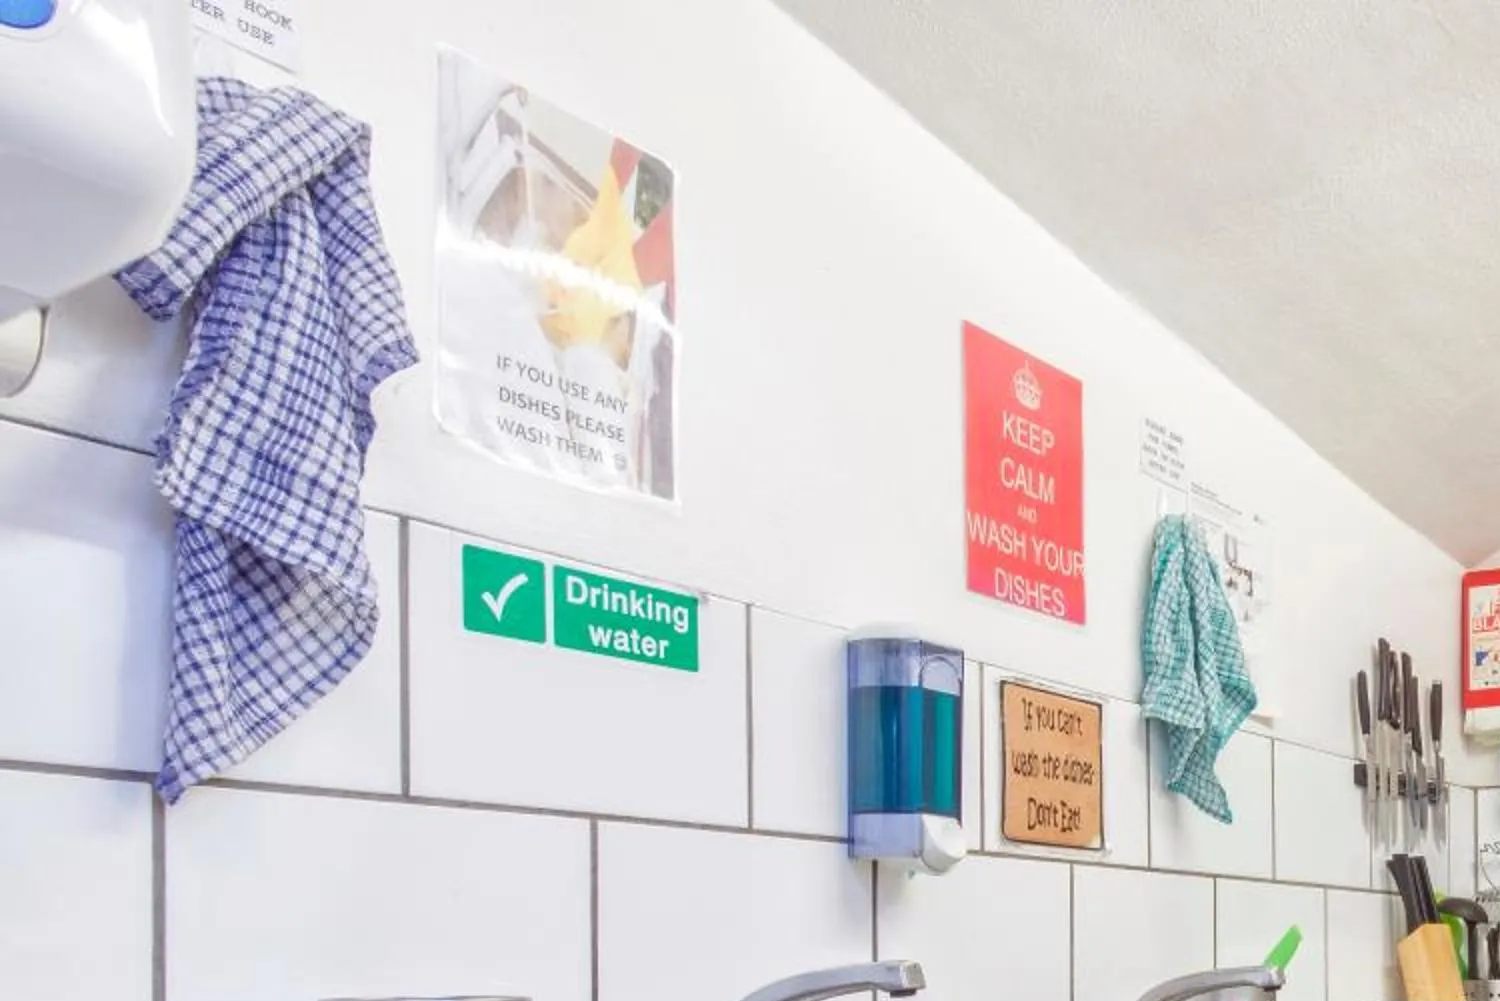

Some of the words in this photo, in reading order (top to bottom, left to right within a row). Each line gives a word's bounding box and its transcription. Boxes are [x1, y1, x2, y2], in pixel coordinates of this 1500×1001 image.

[238, 17, 274, 45] USE
[244, 0, 293, 31] HOOK
[496, 353, 511, 370] IF
[516, 360, 553, 388] YOU
[559, 375, 589, 401] USE
[595, 391, 628, 414] ANY
[499, 385, 560, 421] DISHES
[565, 408, 625, 443] PLEASE
[1003, 410, 1054, 456] KEEP
[497, 415, 551, 446] WASH
[556, 435, 603, 463] THEM
[1001, 457, 1054, 505] CALM
[1017, 504, 1038, 523] AND
[967, 510, 1026, 561] WASH
[1031, 534, 1086, 577] YOUR
[565, 575, 690, 634] Drinking
[994, 567, 1065, 617] DISHES
[588, 624, 671, 659] water
[1042, 751, 1060, 780] the
